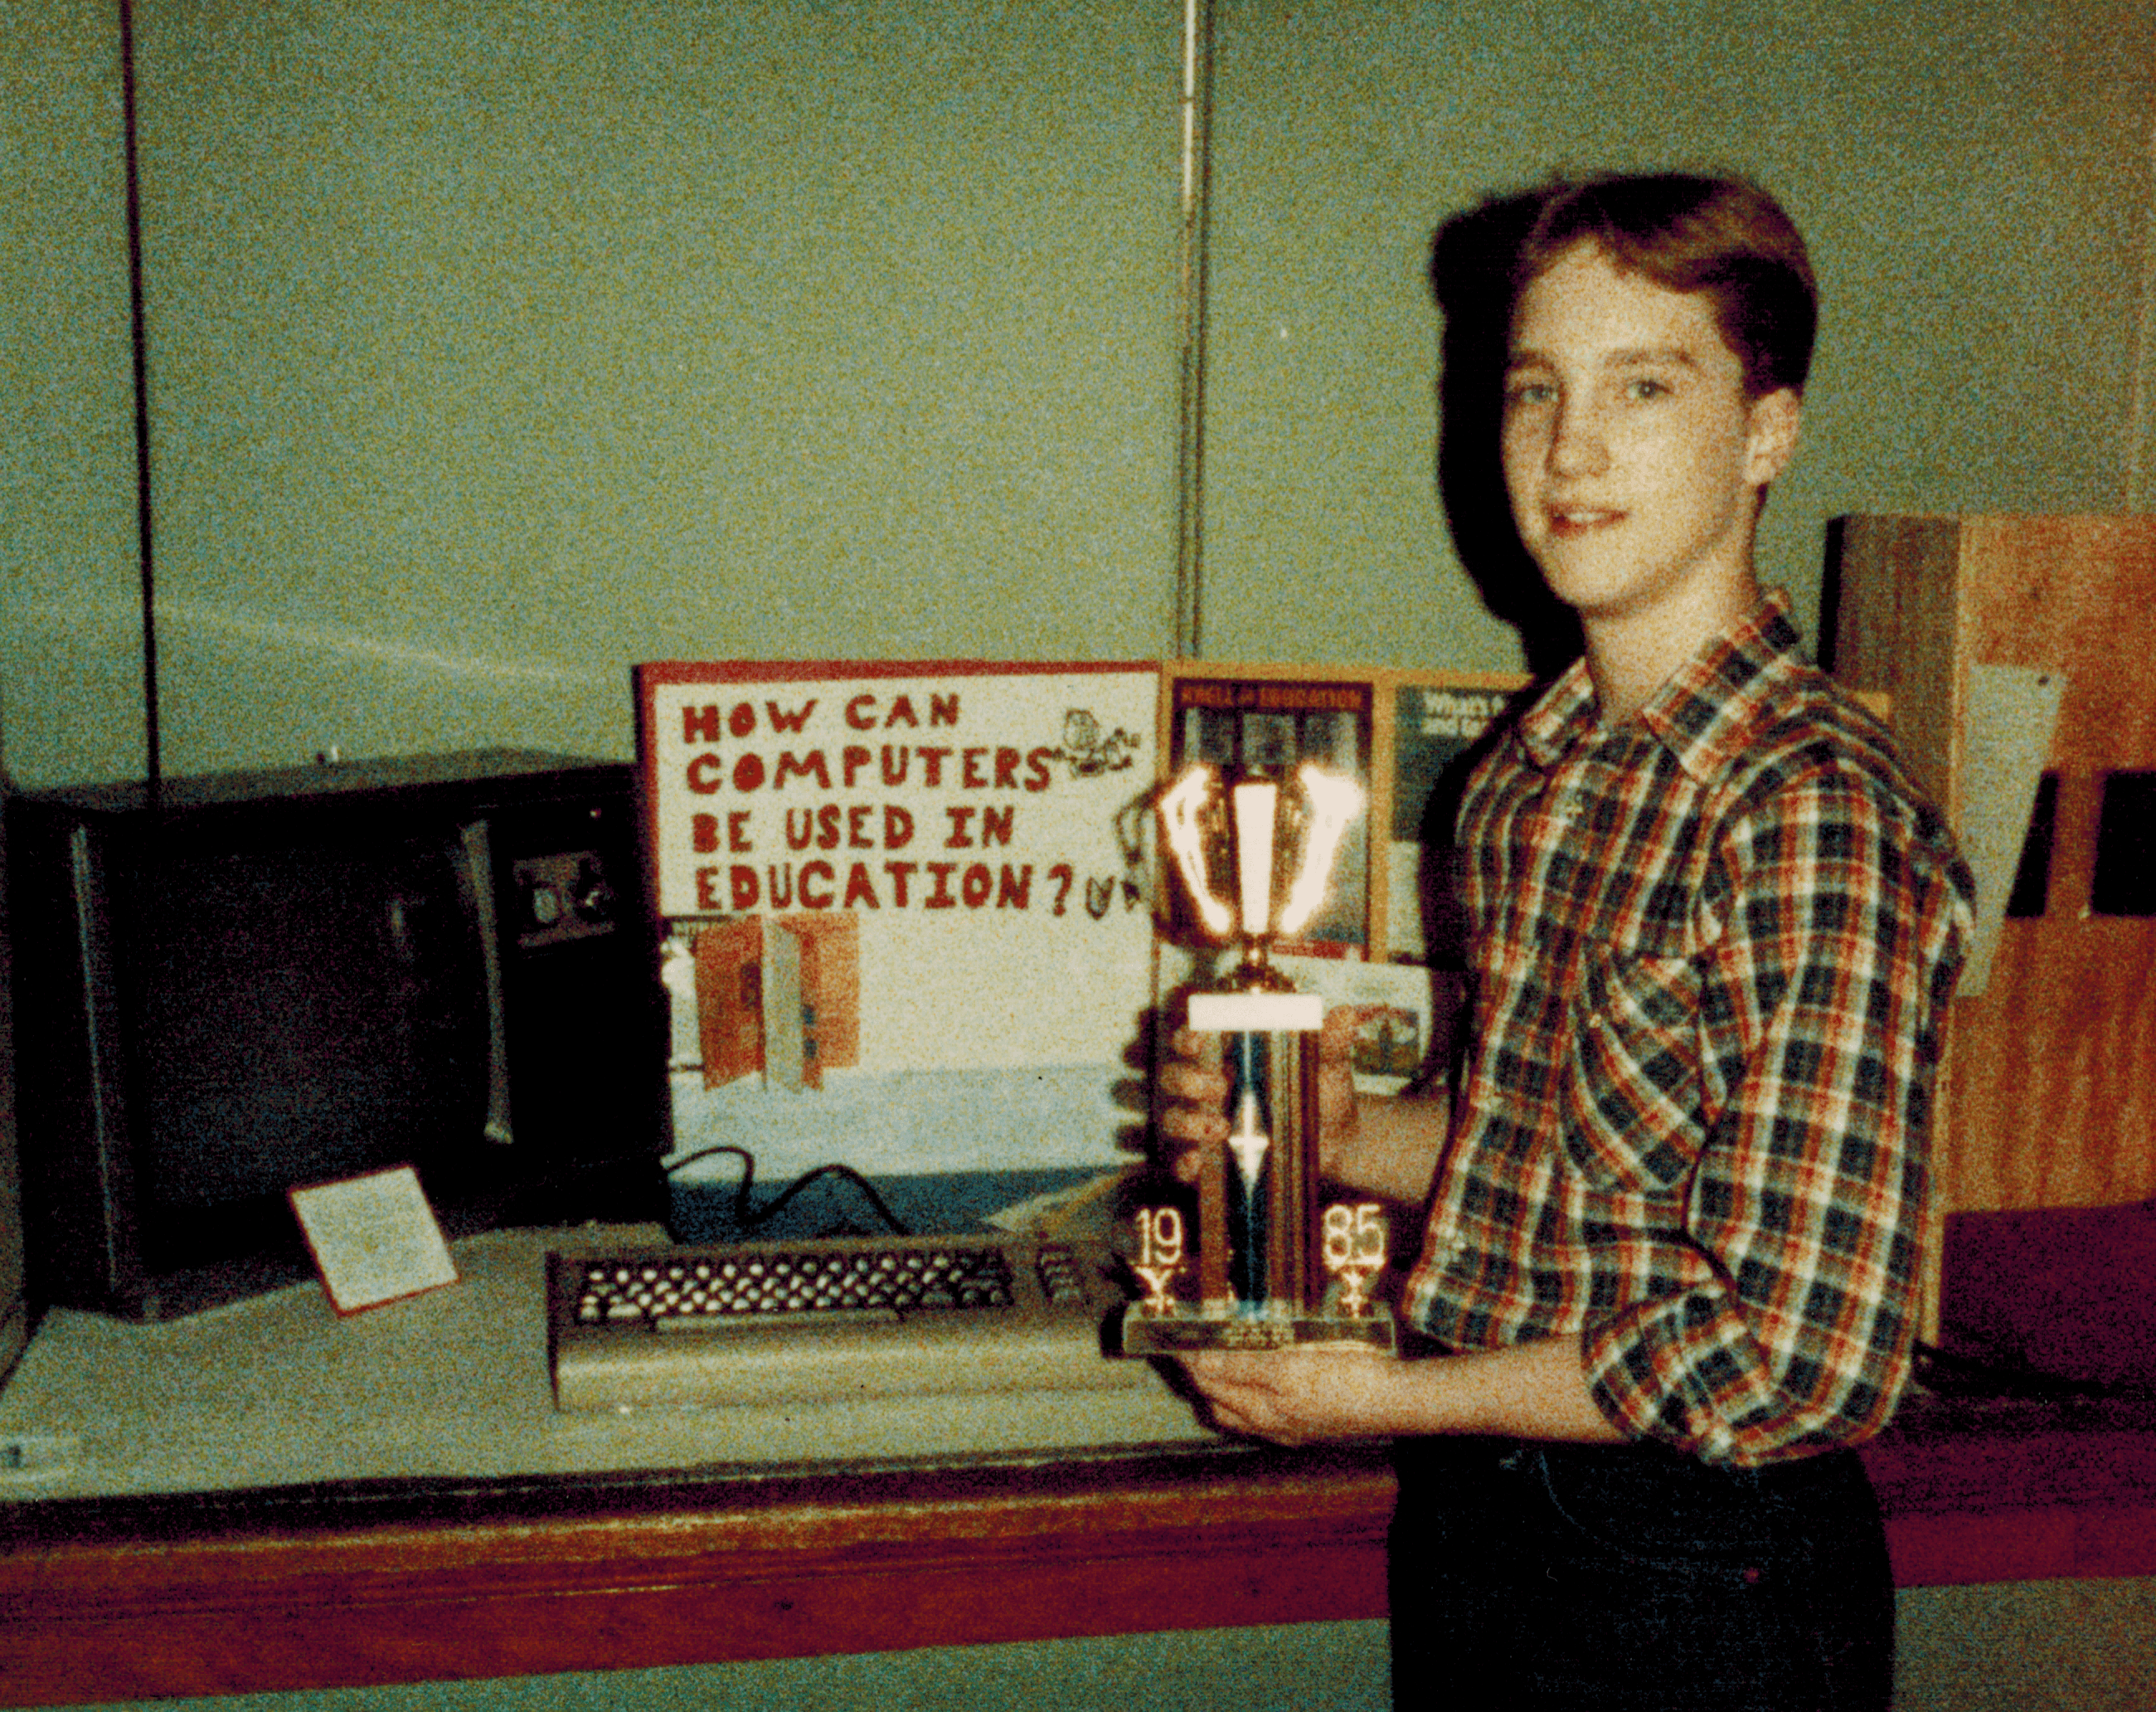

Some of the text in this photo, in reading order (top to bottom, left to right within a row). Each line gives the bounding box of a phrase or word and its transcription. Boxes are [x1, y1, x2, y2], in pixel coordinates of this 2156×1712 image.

[682, 694, 959, 744] HOW CAN
[687, 745, 1051, 795] COMPUTERS
[692, 805, 1013, 854] BE USED IN
[695, 860, 1073, 917] EDUCATION?
[1137, 1203, 1386, 1269] 19 85
